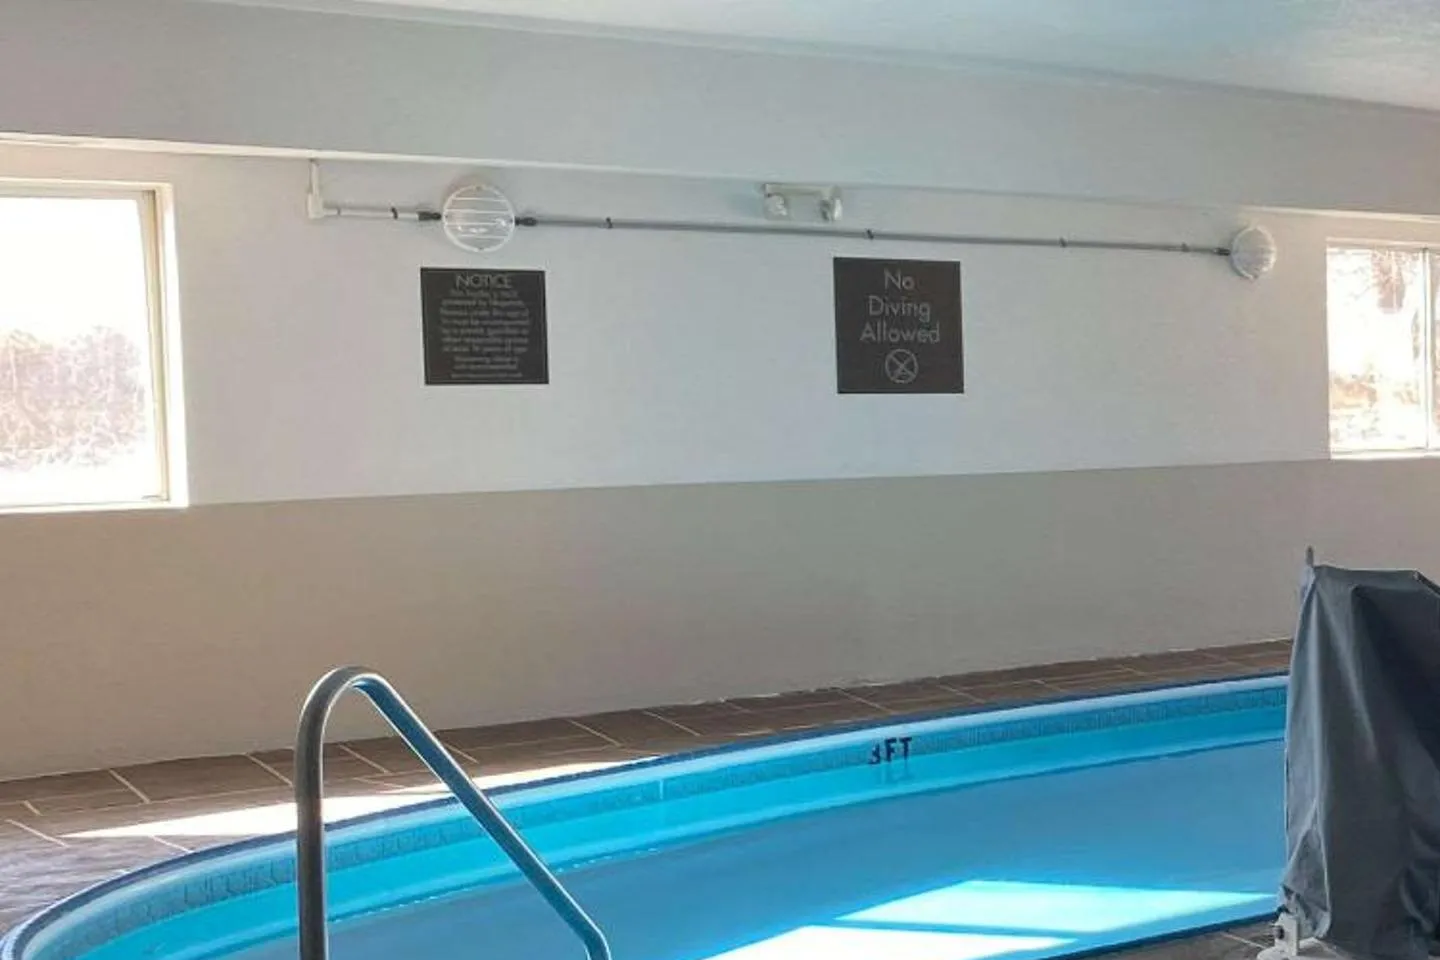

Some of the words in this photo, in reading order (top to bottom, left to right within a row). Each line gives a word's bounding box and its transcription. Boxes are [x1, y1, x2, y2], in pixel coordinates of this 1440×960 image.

[455, 274, 513, 289] NOTICE
[884, 268, 915, 290] No
[868, 295, 931, 323] Diving
[860, 320, 941, 344] Allowed
